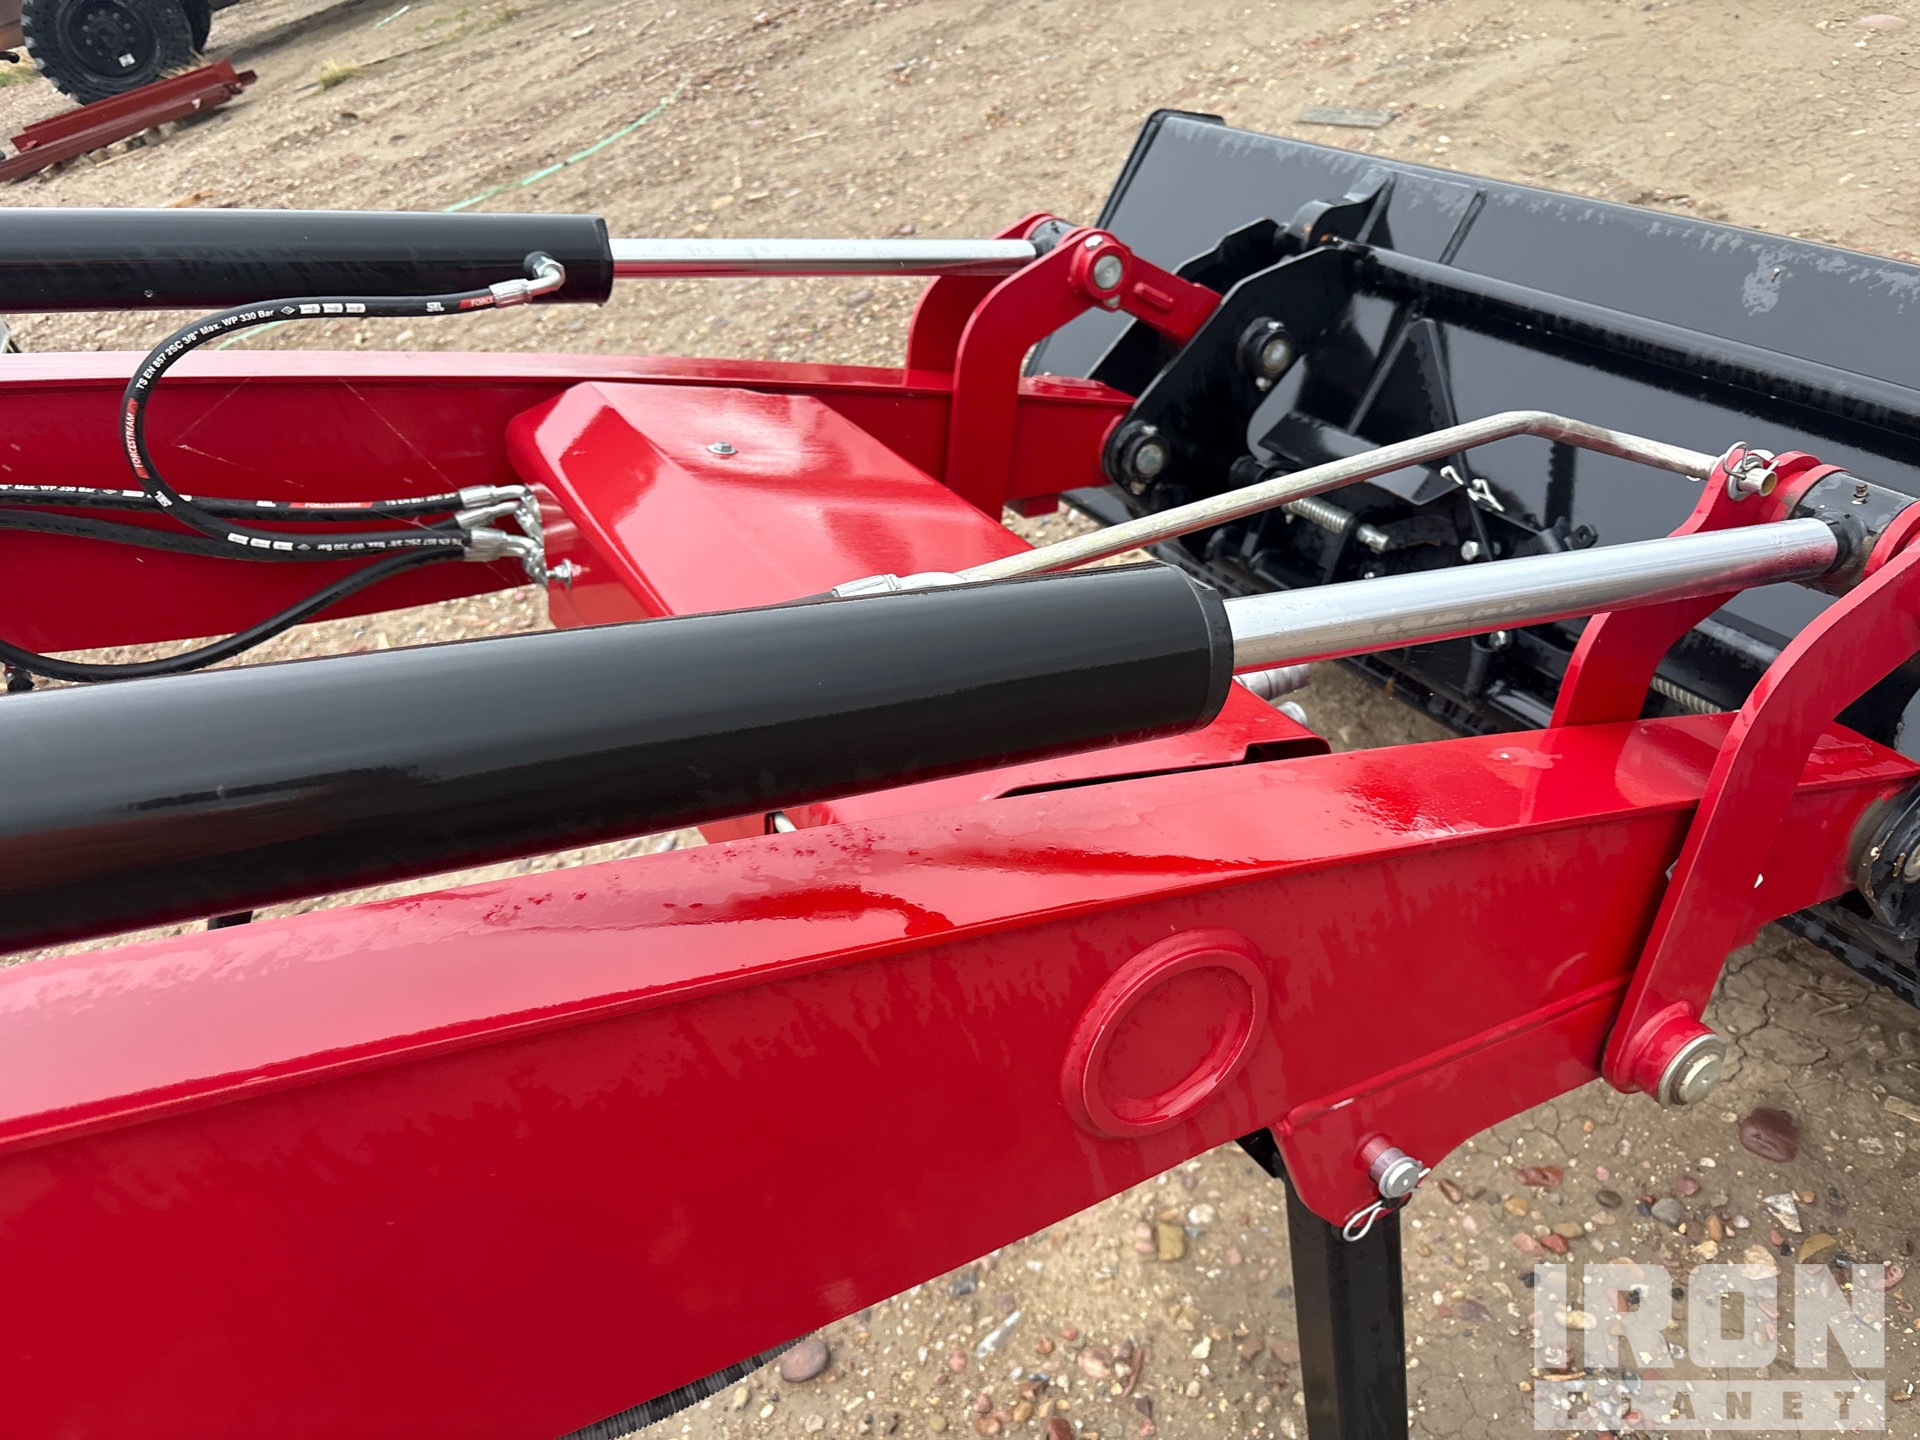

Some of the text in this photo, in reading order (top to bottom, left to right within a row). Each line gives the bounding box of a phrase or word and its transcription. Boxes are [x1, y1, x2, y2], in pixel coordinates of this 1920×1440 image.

[125, 309, 275, 468] FORCESTREAM TS EN 857 2SC 3/8" Max. WP 330 Bar
